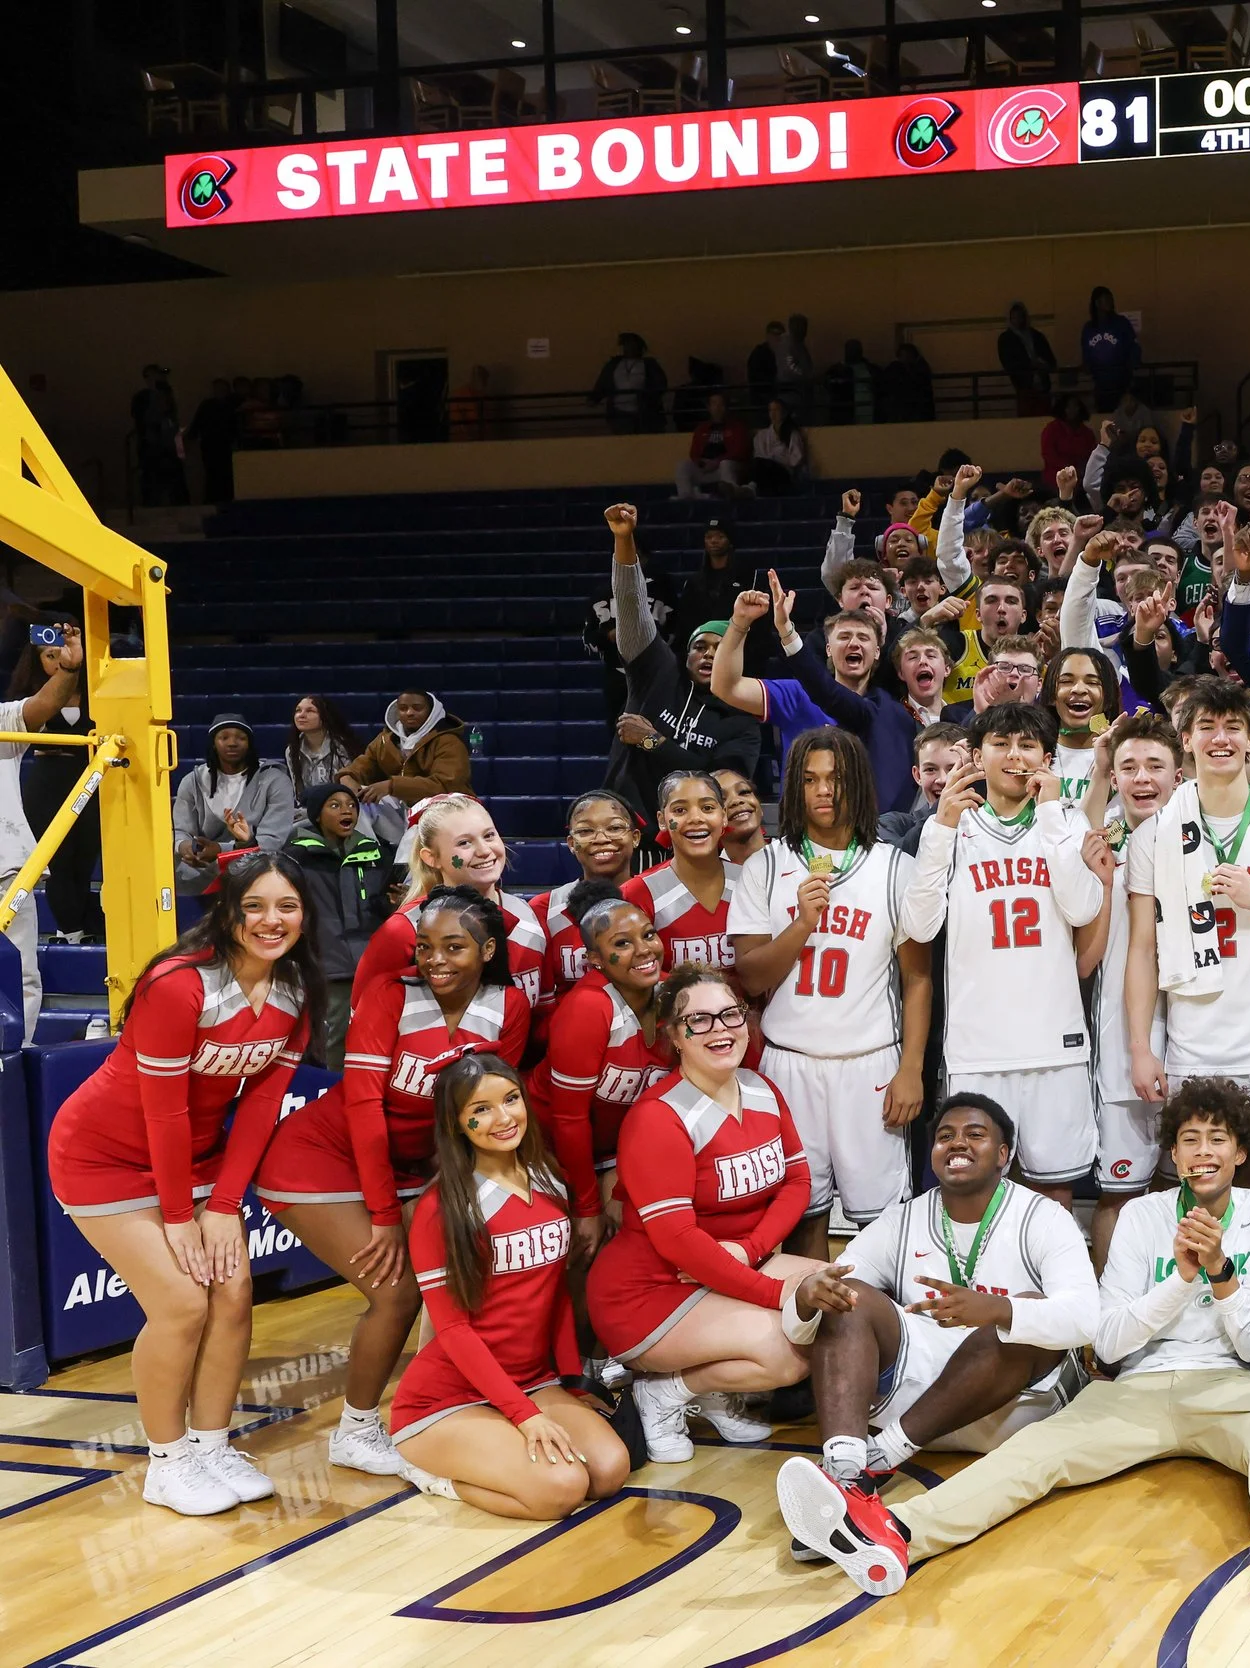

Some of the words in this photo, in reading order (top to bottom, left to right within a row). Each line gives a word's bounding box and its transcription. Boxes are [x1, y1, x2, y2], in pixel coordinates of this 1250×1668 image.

[1080, 96, 1149, 148] 81
[277, 139, 508, 210] STATE
[537, 111, 848, 191] BOUND!
[968, 857, 1051, 893] IRISH
[988, 897, 1042, 950] 12
[671, 934, 736, 969] IRIS
[794, 945, 850, 998] 10
[63, 1268, 133, 1310] Ale
